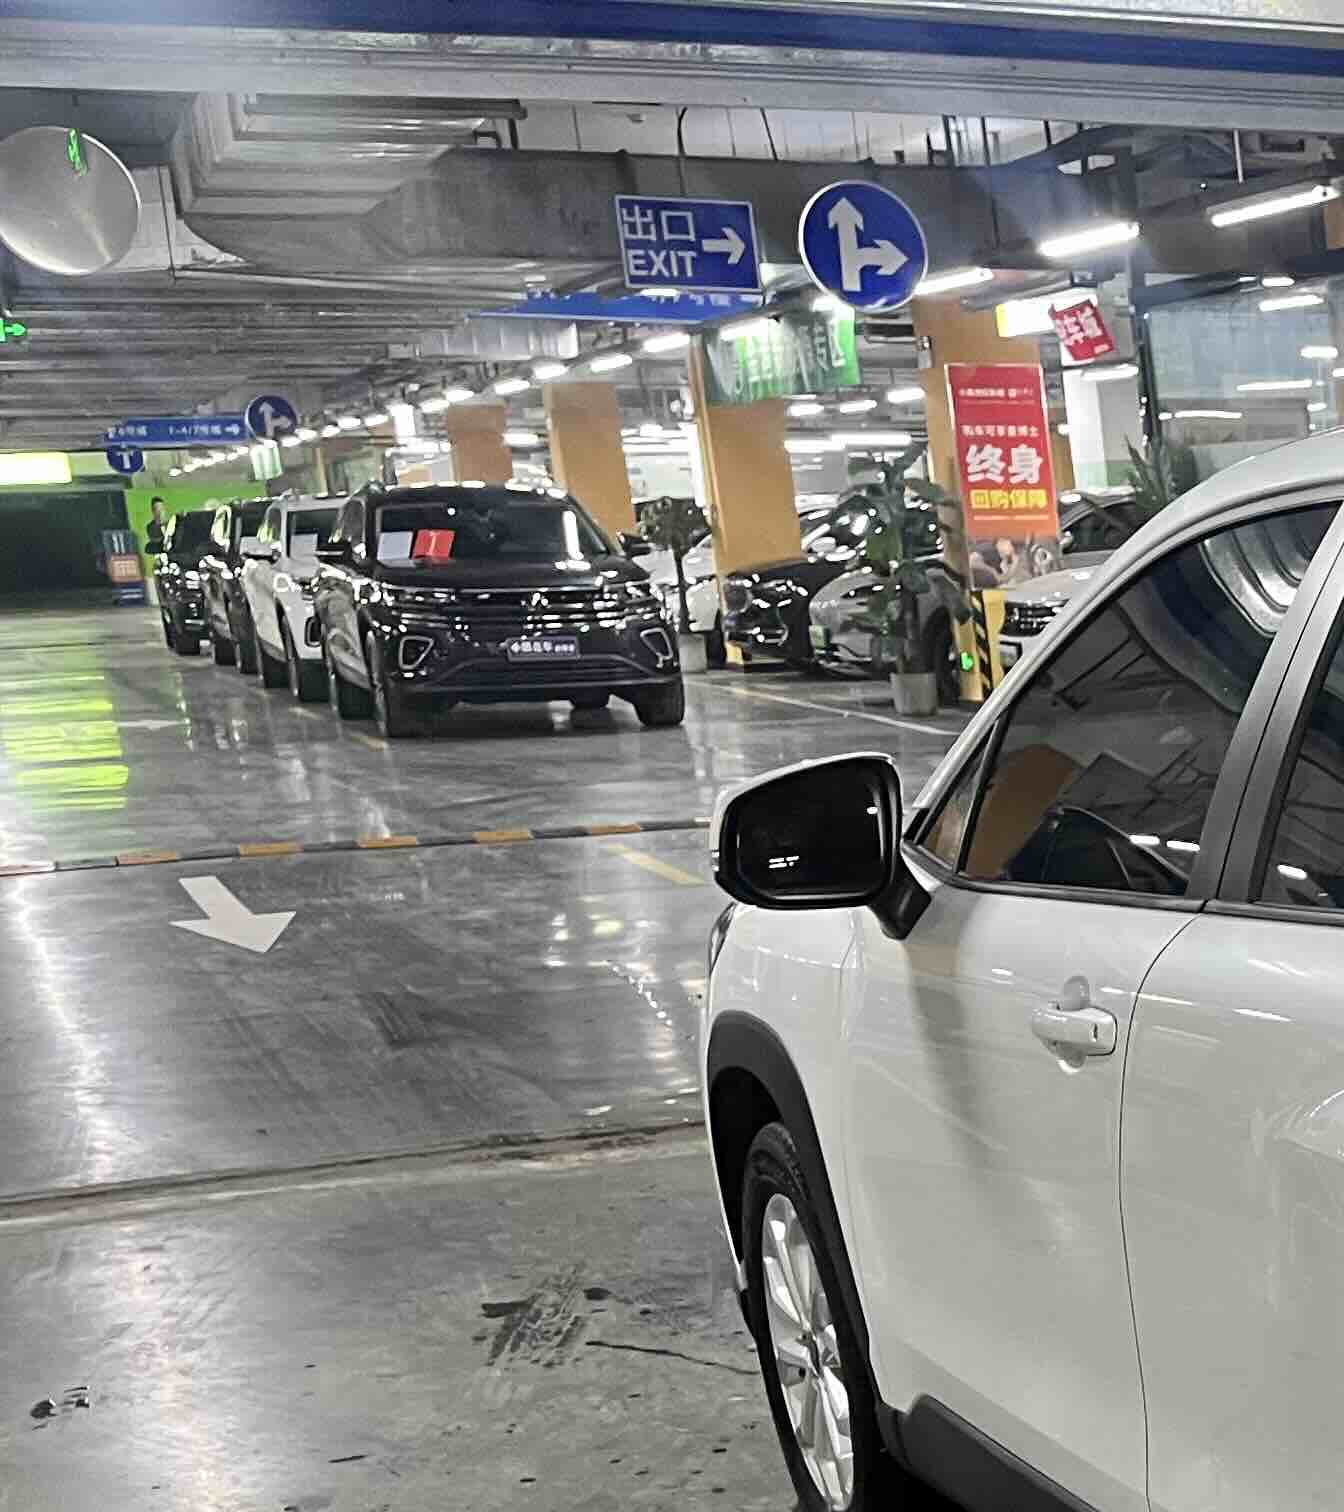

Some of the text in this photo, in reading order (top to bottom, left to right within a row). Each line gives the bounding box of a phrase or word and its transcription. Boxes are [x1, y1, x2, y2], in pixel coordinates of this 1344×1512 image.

[622, 205, 696, 241] 出口
[627, 249, 697, 278] EXIT
[966, 444, 1043, 483] 终身
[970, 488, 1048, 509] 回购保障
